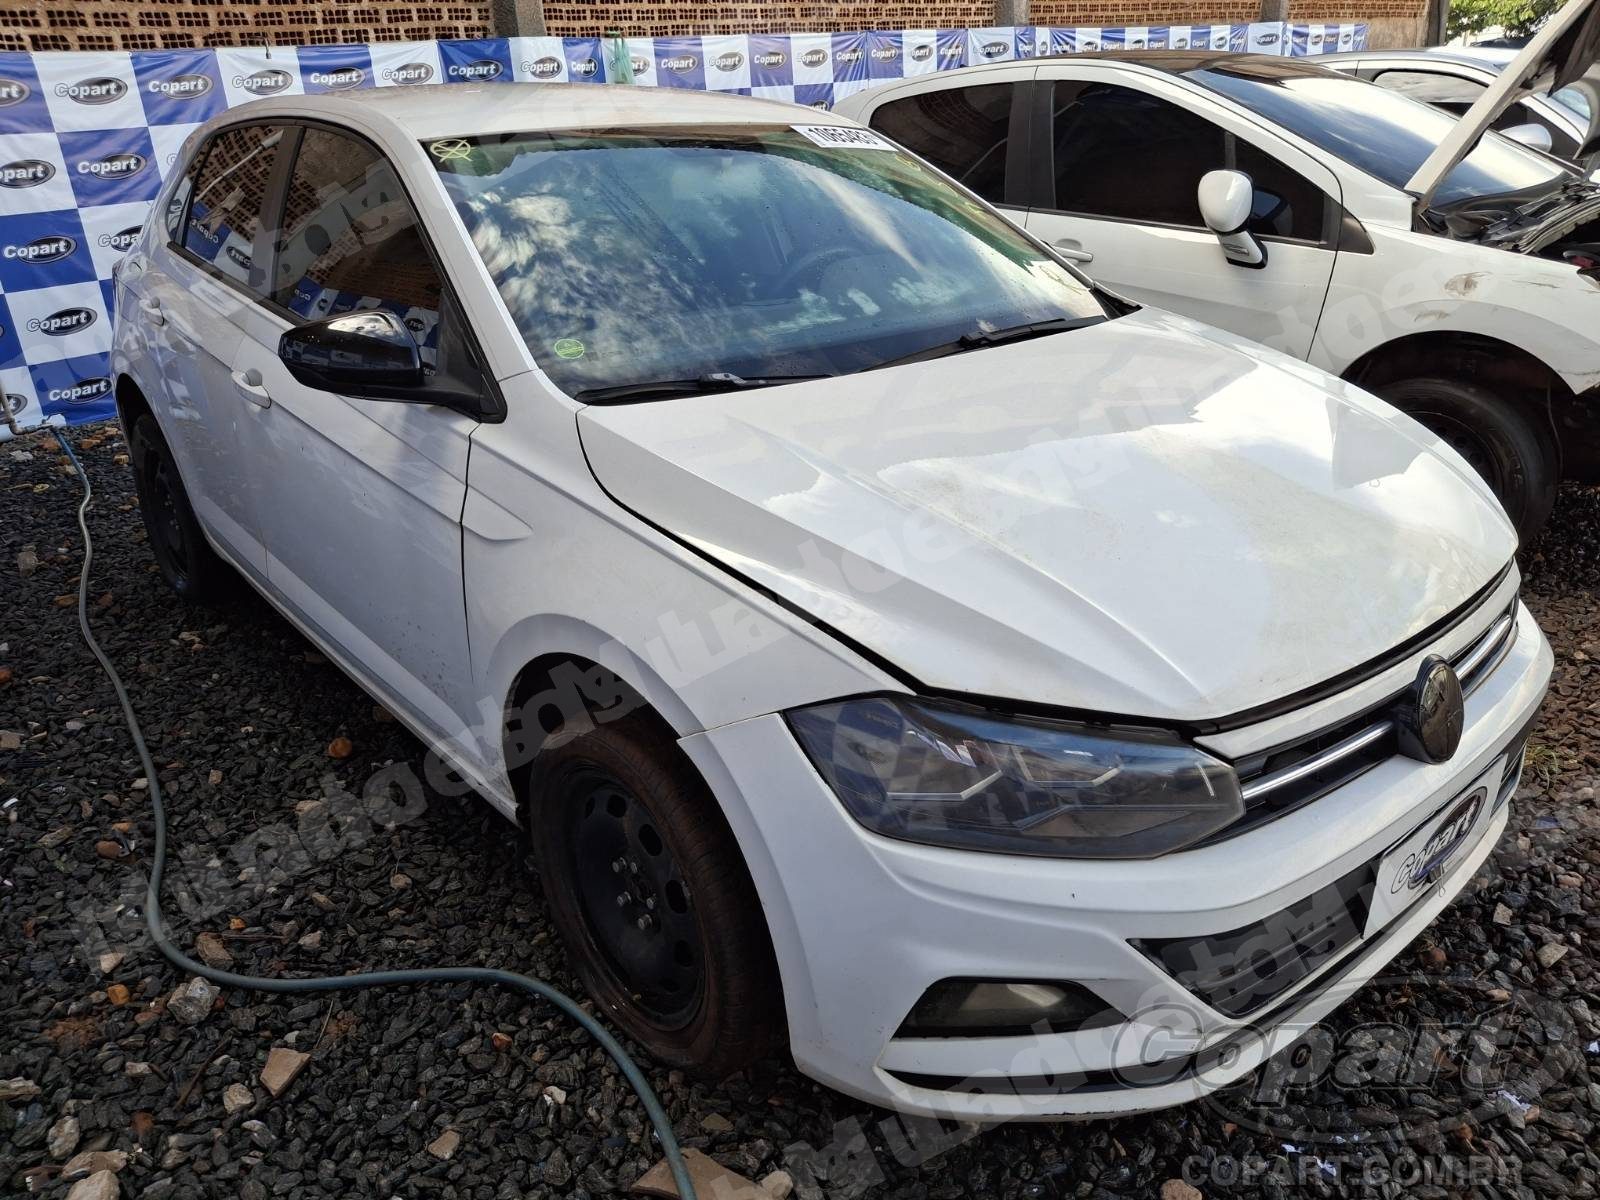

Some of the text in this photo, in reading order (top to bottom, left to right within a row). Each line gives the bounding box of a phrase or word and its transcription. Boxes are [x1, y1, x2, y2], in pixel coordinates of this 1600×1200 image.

[797, 53, 823, 62] opart
[836, 51, 862, 62] Copart
[871, 48, 895, 58] Copart
[571, 61, 595, 72] Copart
[661, 59, 693, 69] Copart
[709, 56, 739, 67] Copart
[754, 55, 782, 65] Copart
[448, 64, 496, 77] Copart
[520, 61, 558, 73] Copart
[310, 72, 358, 85] Copart
[381, 67, 426, 81] Copart
[148, 78, 204, 94] Copart
[232, 74, 284, 89] Copart
[55, 82, 118, 98] Copart
[77, 158, 137, 174] Copart
[98, 233, 141, 247] Copa
[3, 240, 67, 258] Copart
[27, 312, 87, 332] Copart
[49, 381, 107, 401] Copart
[1391, 799, 1479, 894] Copart
